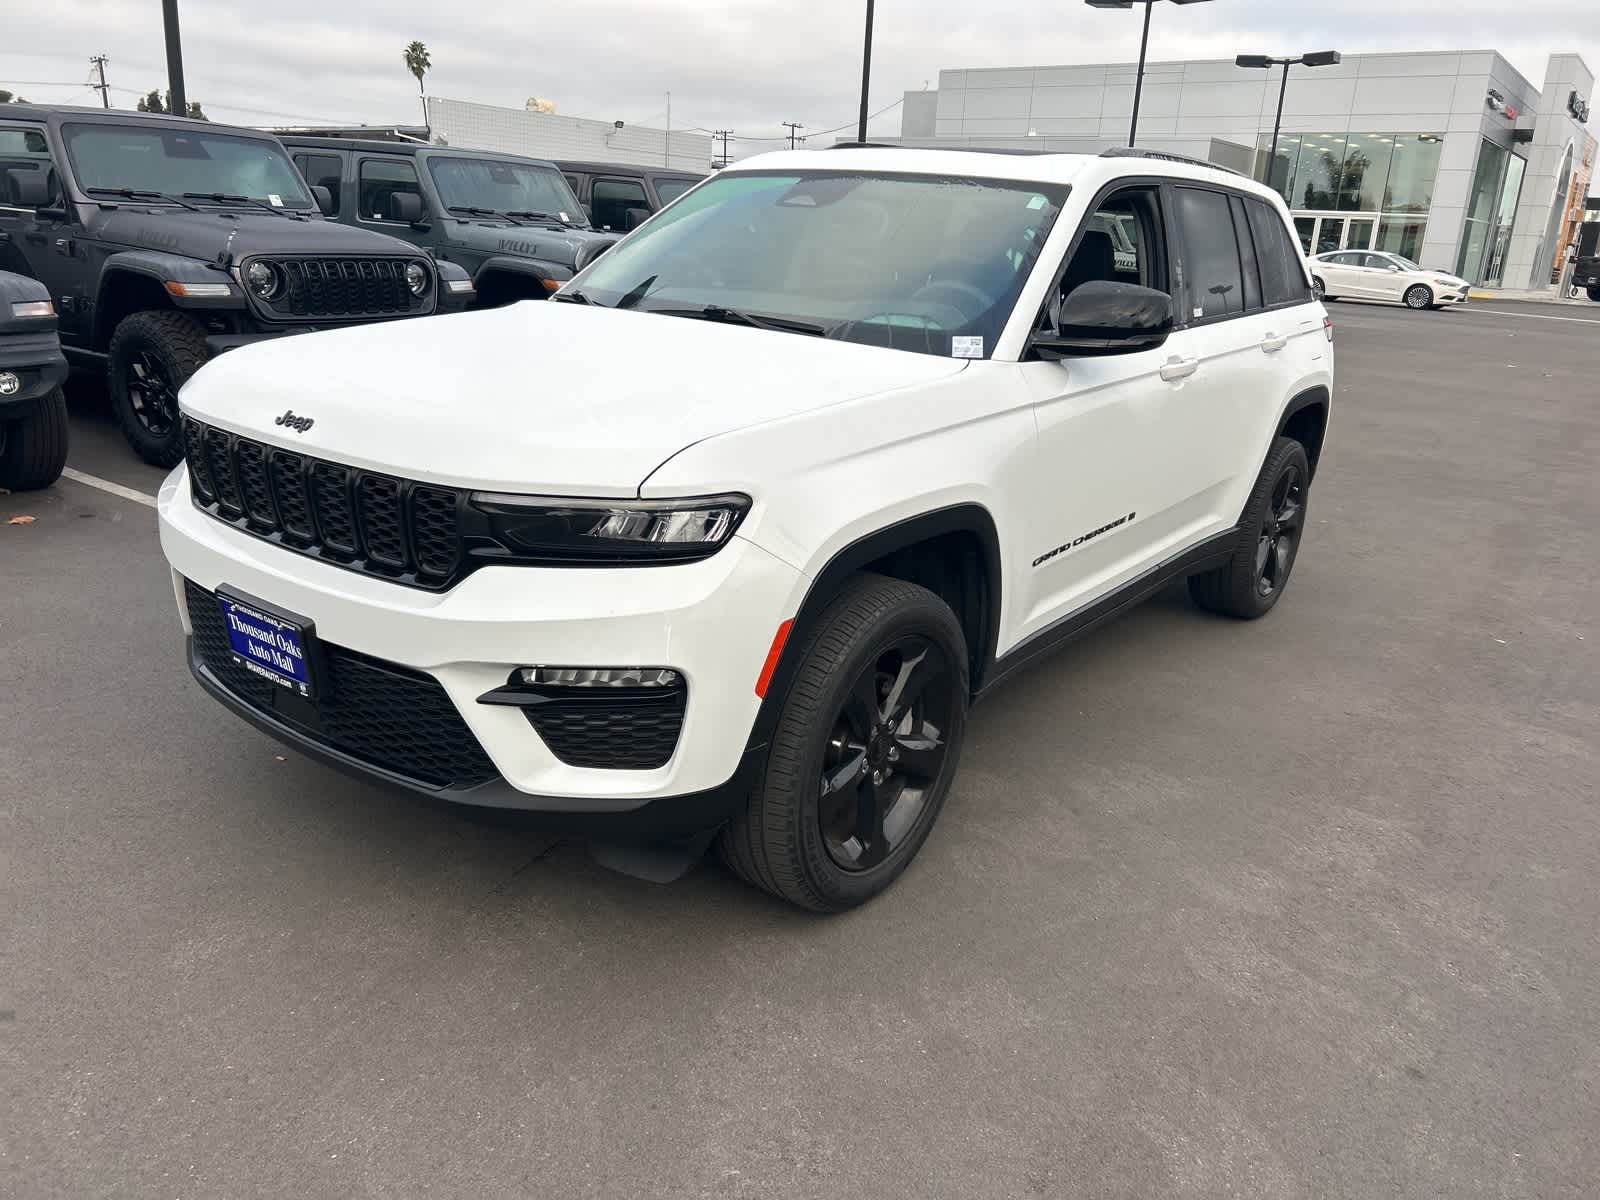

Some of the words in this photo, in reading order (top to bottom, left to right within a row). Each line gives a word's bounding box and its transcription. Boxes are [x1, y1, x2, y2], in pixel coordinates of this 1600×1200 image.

[275, 409, 314, 434] Jeep
[1032, 543, 1071, 567] GRAND
[1072, 516, 1127, 546] CHEROKEE
[228, 613, 276, 647] Thousand
[277, 633, 302, 659] Oaks
[248, 639, 270, 662] Auto
[270, 649, 295, 673] Mall
